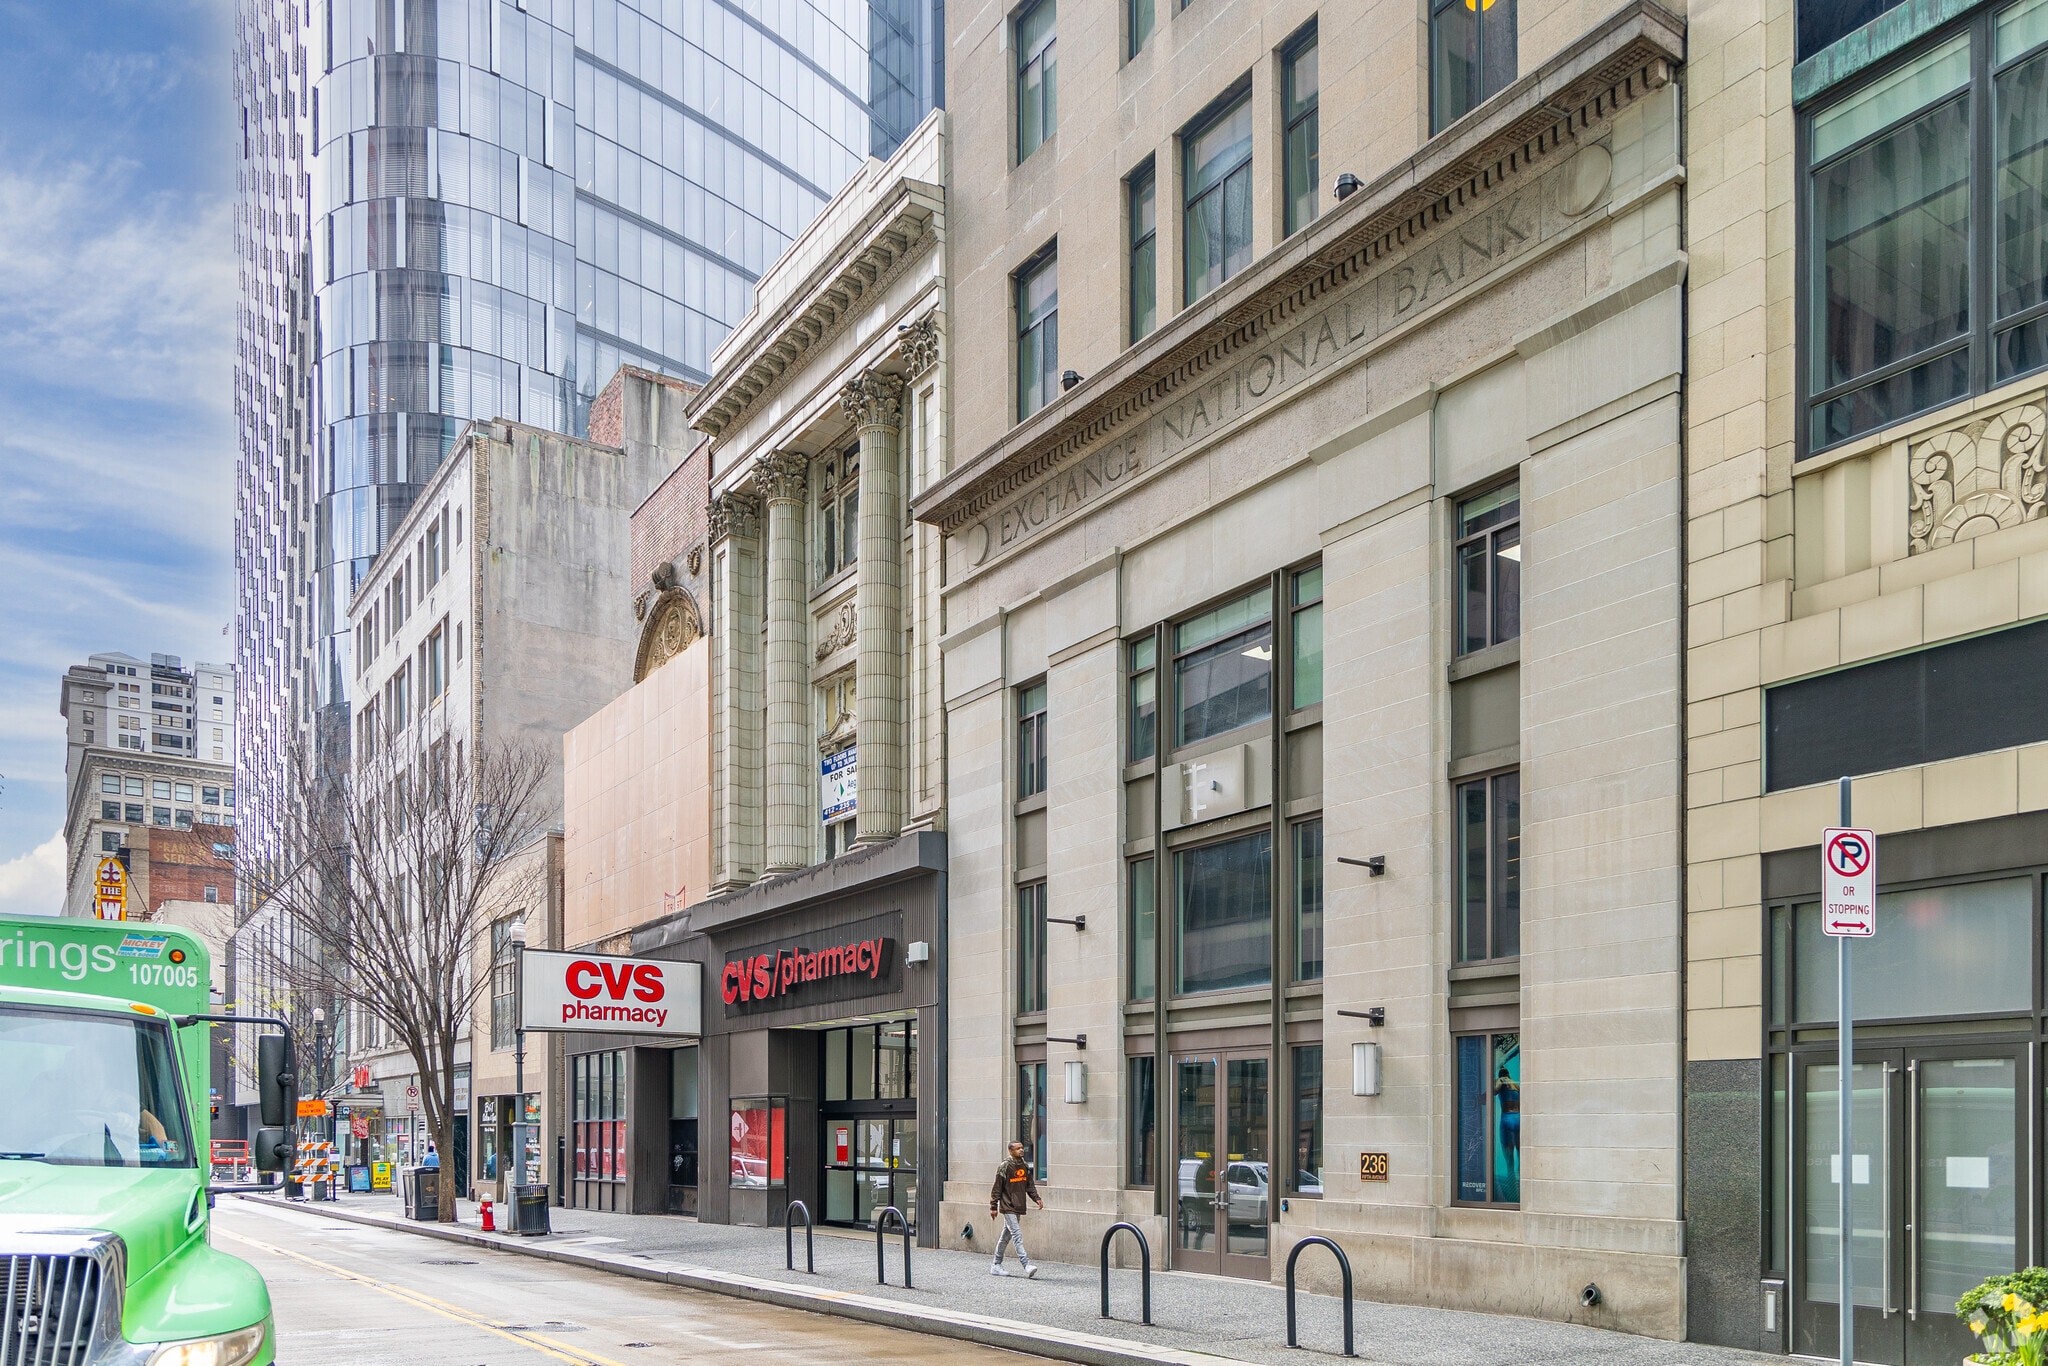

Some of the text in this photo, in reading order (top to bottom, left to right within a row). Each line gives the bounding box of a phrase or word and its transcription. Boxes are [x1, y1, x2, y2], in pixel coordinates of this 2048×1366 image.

[1000, 196, 1529, 546] EXCHANGE NATIONAL BANK
[830, 770, 843, 783] FOR
[101, 886, 121, 896] THE
[1842, 885, 1855, 896] OR
[1828, 904, 1870, 915] STOPPING
[122, 939, 164, 949] MICKEY
[0, 930, 117, 981] rings
[129, 963, 198, 988] 107005
[565, 960, 665, 1003] CVS
[562, 1000, 668, 1027] pharmacy
[1362, 1155, 1386, 1174] 236
